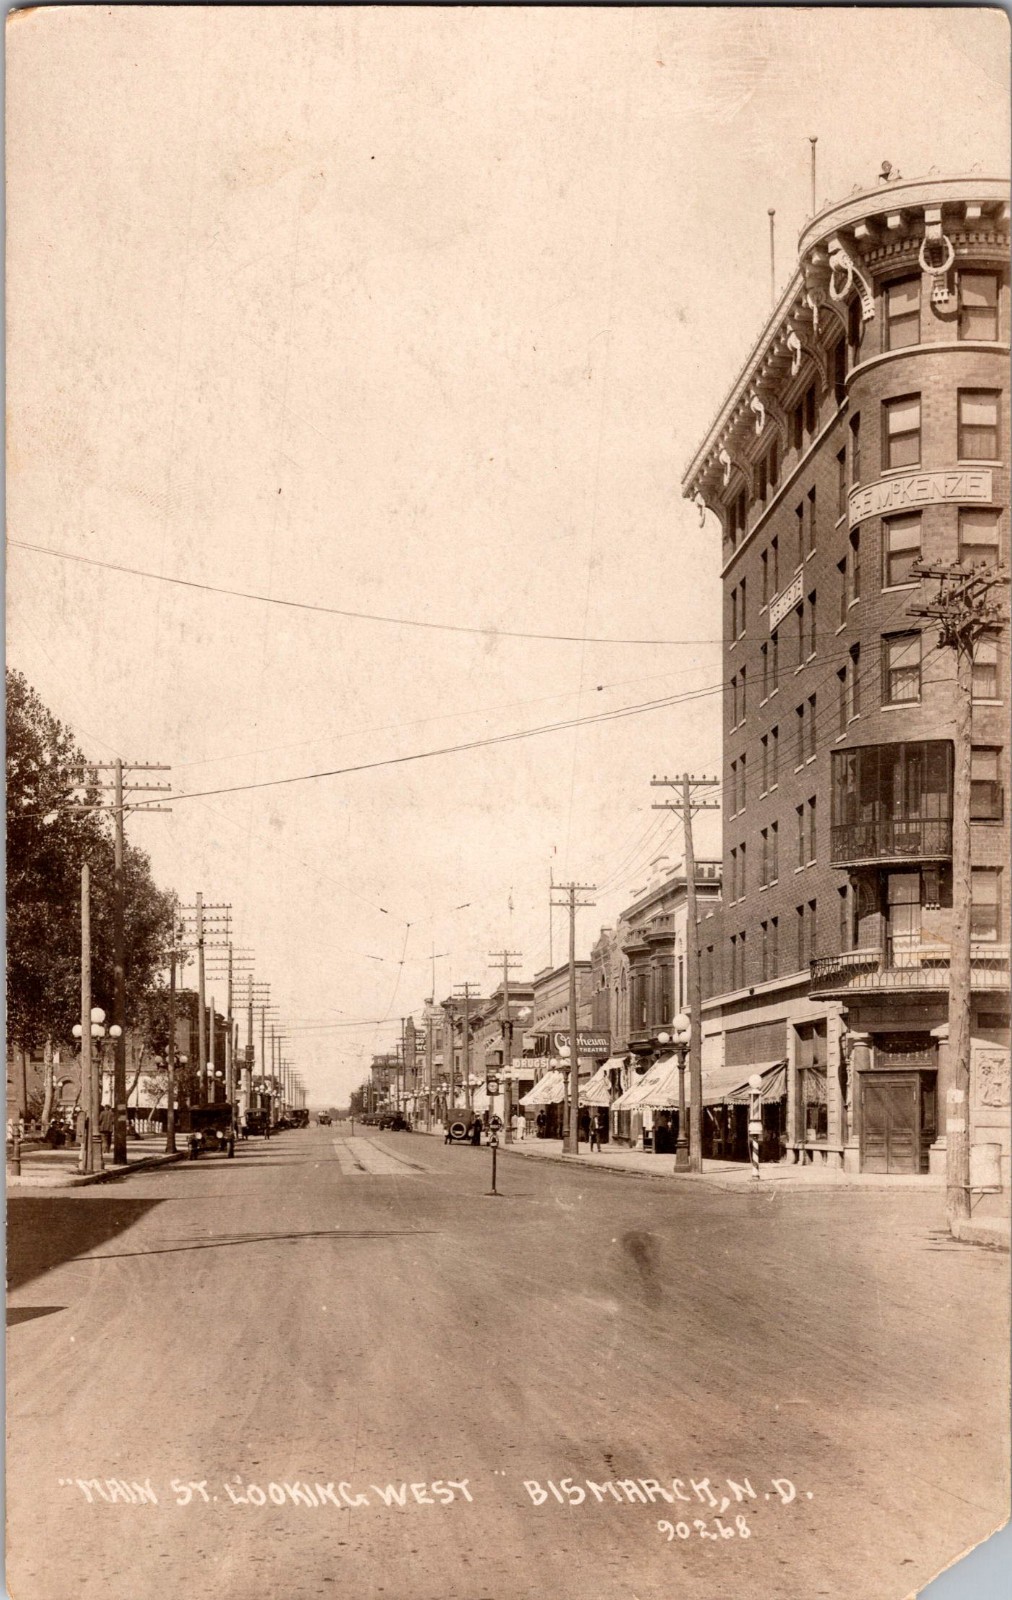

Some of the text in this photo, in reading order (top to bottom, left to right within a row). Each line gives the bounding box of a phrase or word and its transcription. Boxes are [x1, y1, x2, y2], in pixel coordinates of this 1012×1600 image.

[553, 1032, 609, 1052] Orheum
[579, 1046, 608, 1054] THEATRE
[513, 1059, 547, 1069] DRUGS
